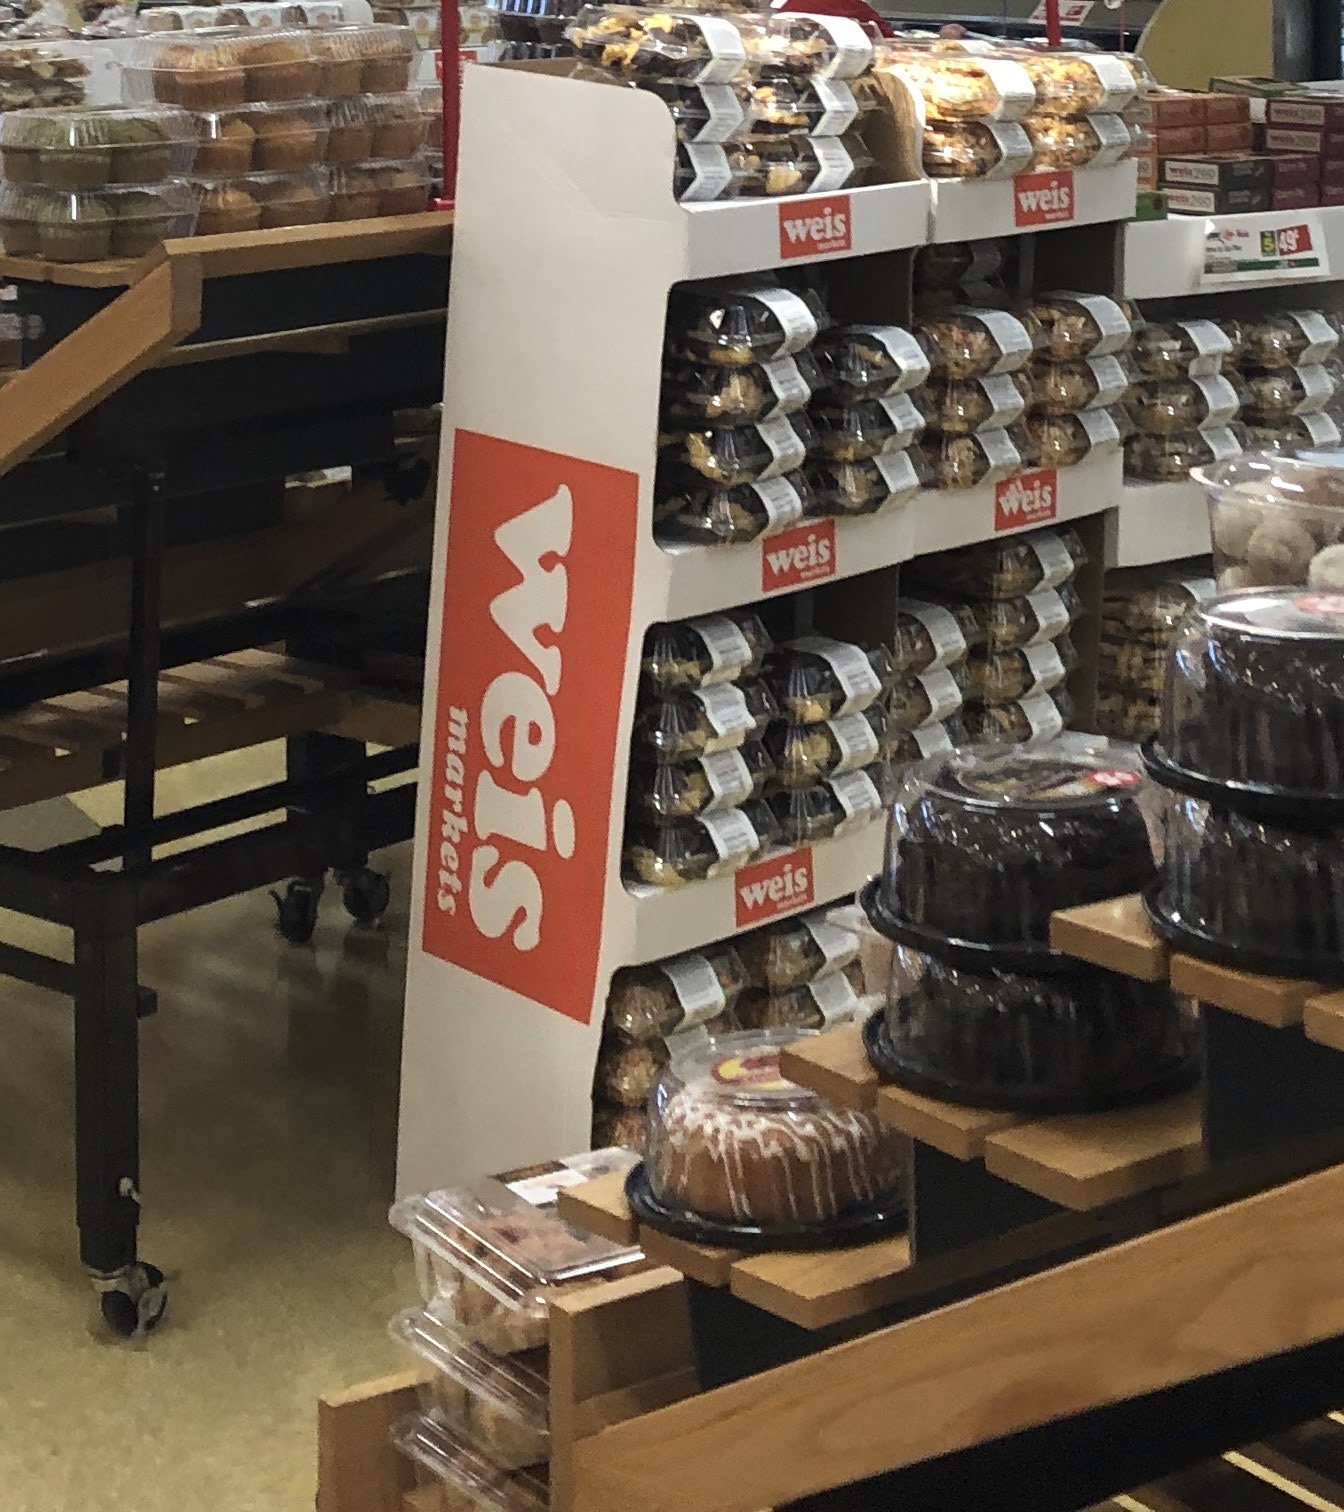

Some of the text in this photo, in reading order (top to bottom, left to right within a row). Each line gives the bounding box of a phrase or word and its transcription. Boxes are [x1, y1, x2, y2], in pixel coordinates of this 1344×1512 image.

[1017, 180, 1071, 214] weis
[783, 206, 847, 245] weis
[998, 478, 1052, 516] weis
[765, 533, 831, 575] weis
[469, 484, 576, 951] weis
[435, 704, 470, 917] markets
[740, 863, 808, 910] weis
